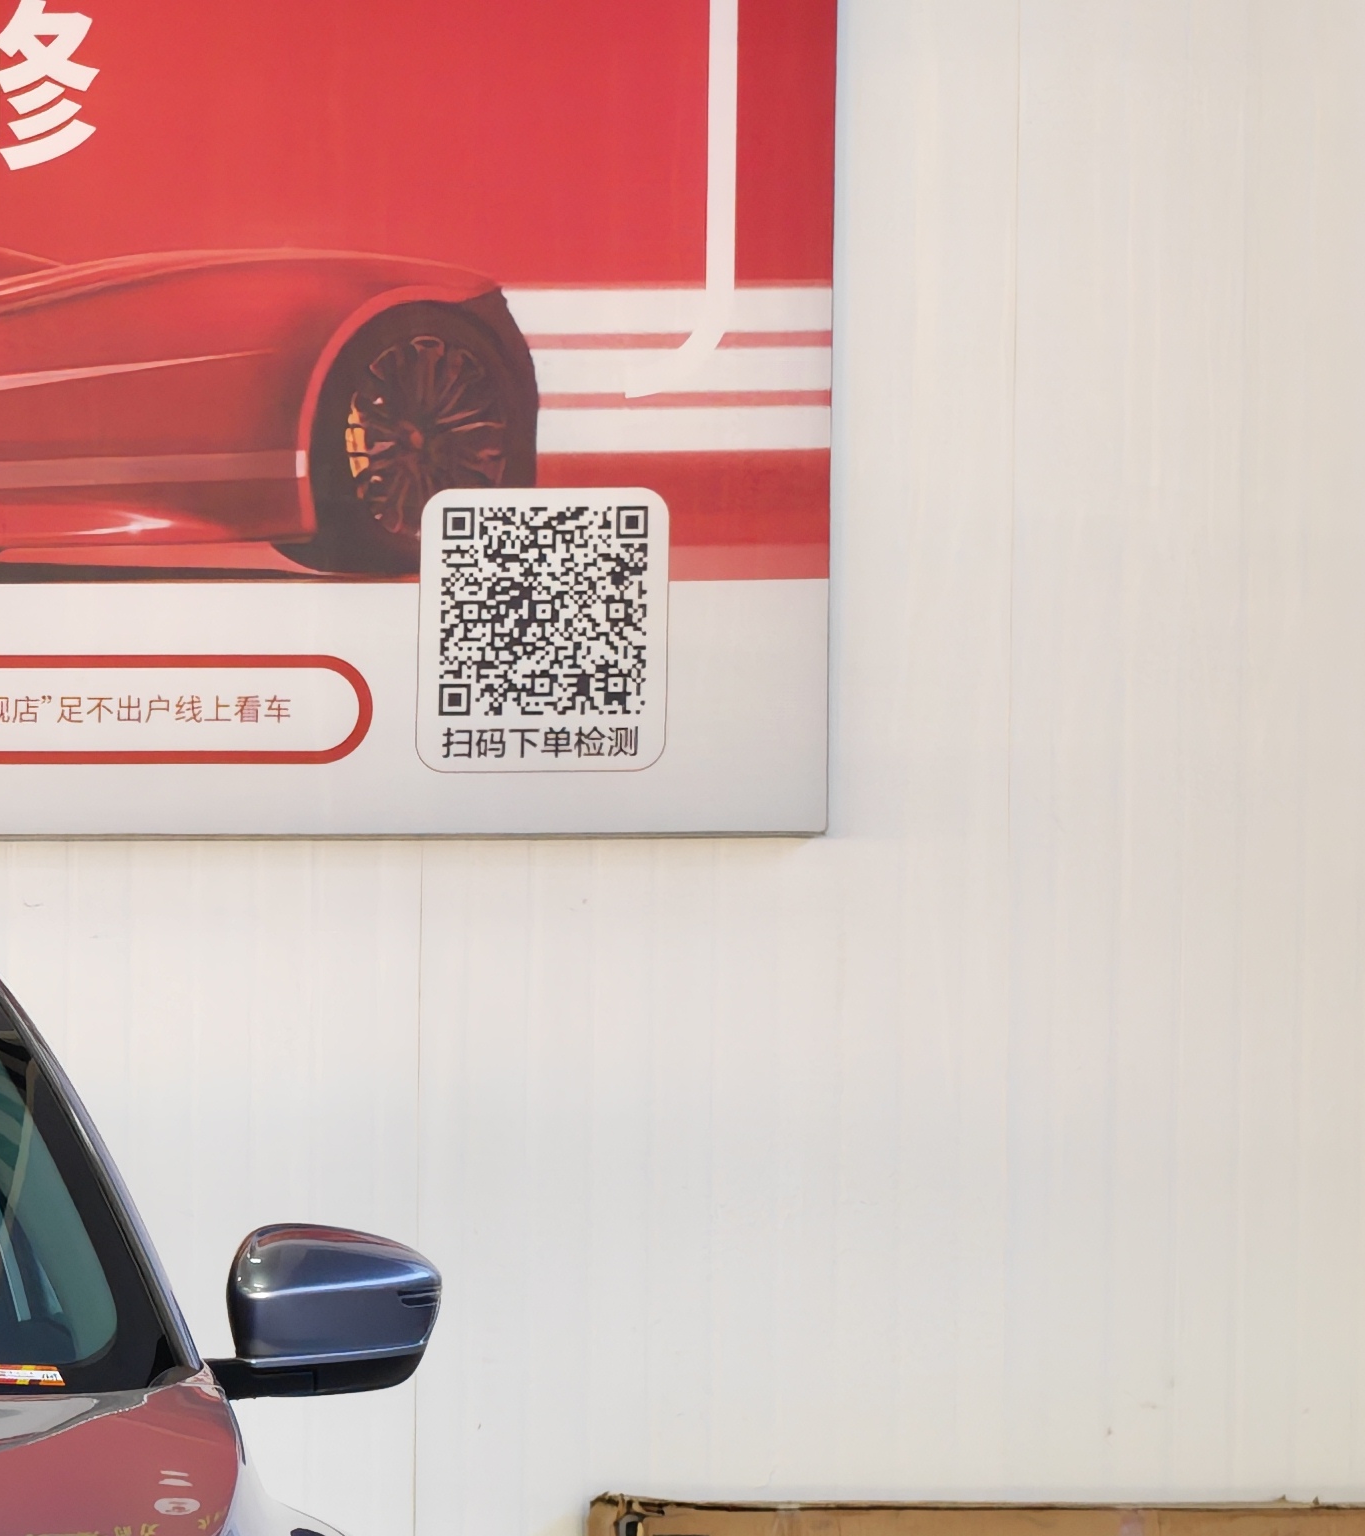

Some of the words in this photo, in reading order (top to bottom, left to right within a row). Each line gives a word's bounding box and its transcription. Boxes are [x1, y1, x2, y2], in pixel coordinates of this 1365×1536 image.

[441, 725, 639, 758] 扫码下单检测
